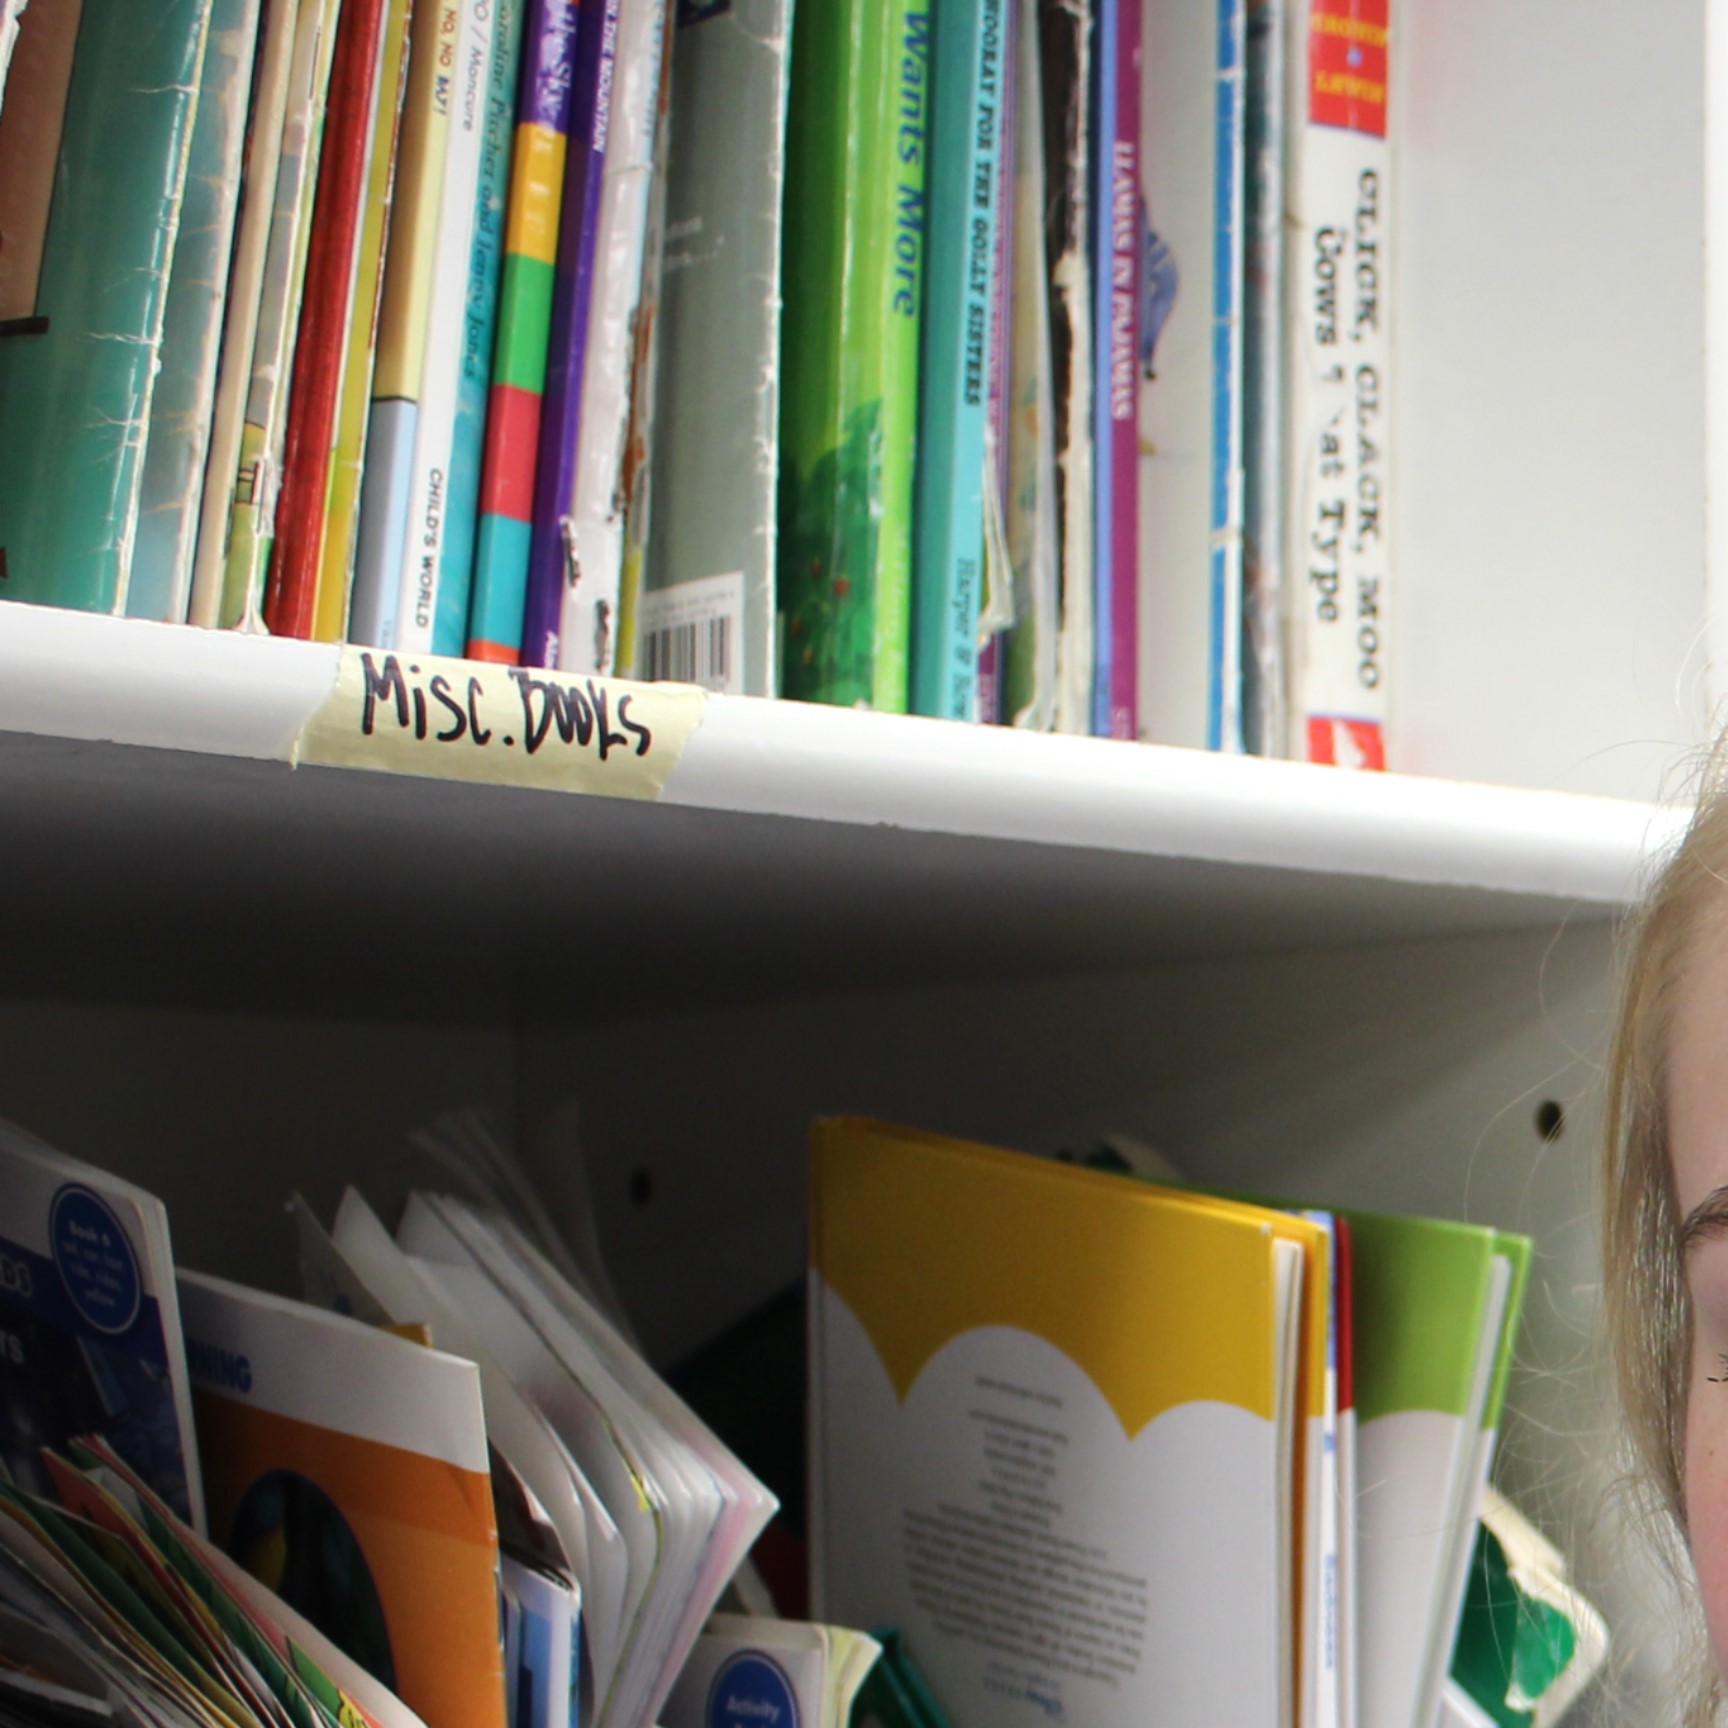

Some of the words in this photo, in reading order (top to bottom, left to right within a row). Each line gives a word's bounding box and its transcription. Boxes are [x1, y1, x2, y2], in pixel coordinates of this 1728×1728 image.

[463, 46, 483, 132] Moncure
[592, 57, 614, 153] MOUNTAIN
[897, 11, 930, 166] Wants
[975, 103, 996, 152] FOR
[970, 161, 992, 210] THE
[893, 183, 925, 318] More
[1112, 256, 1134, 288] IN
[1314, 226, 1347, 346] Cows
[1347, 168, 1379, 344] CLICK,
[961, 303, 985, 407] SISTERS
[1110, 291, 1134, 421] PAJAMAS
[423, 468, 444, 549] CHILD'S
[1353, 363, 1380, 554] CLACK,
[415, 552, 436, 629] WORLD
[1309, 501, 1346, 623] Type
[1356, 576, 1381, 690] MOO
[726, 1693, 781, 1726] Activity
